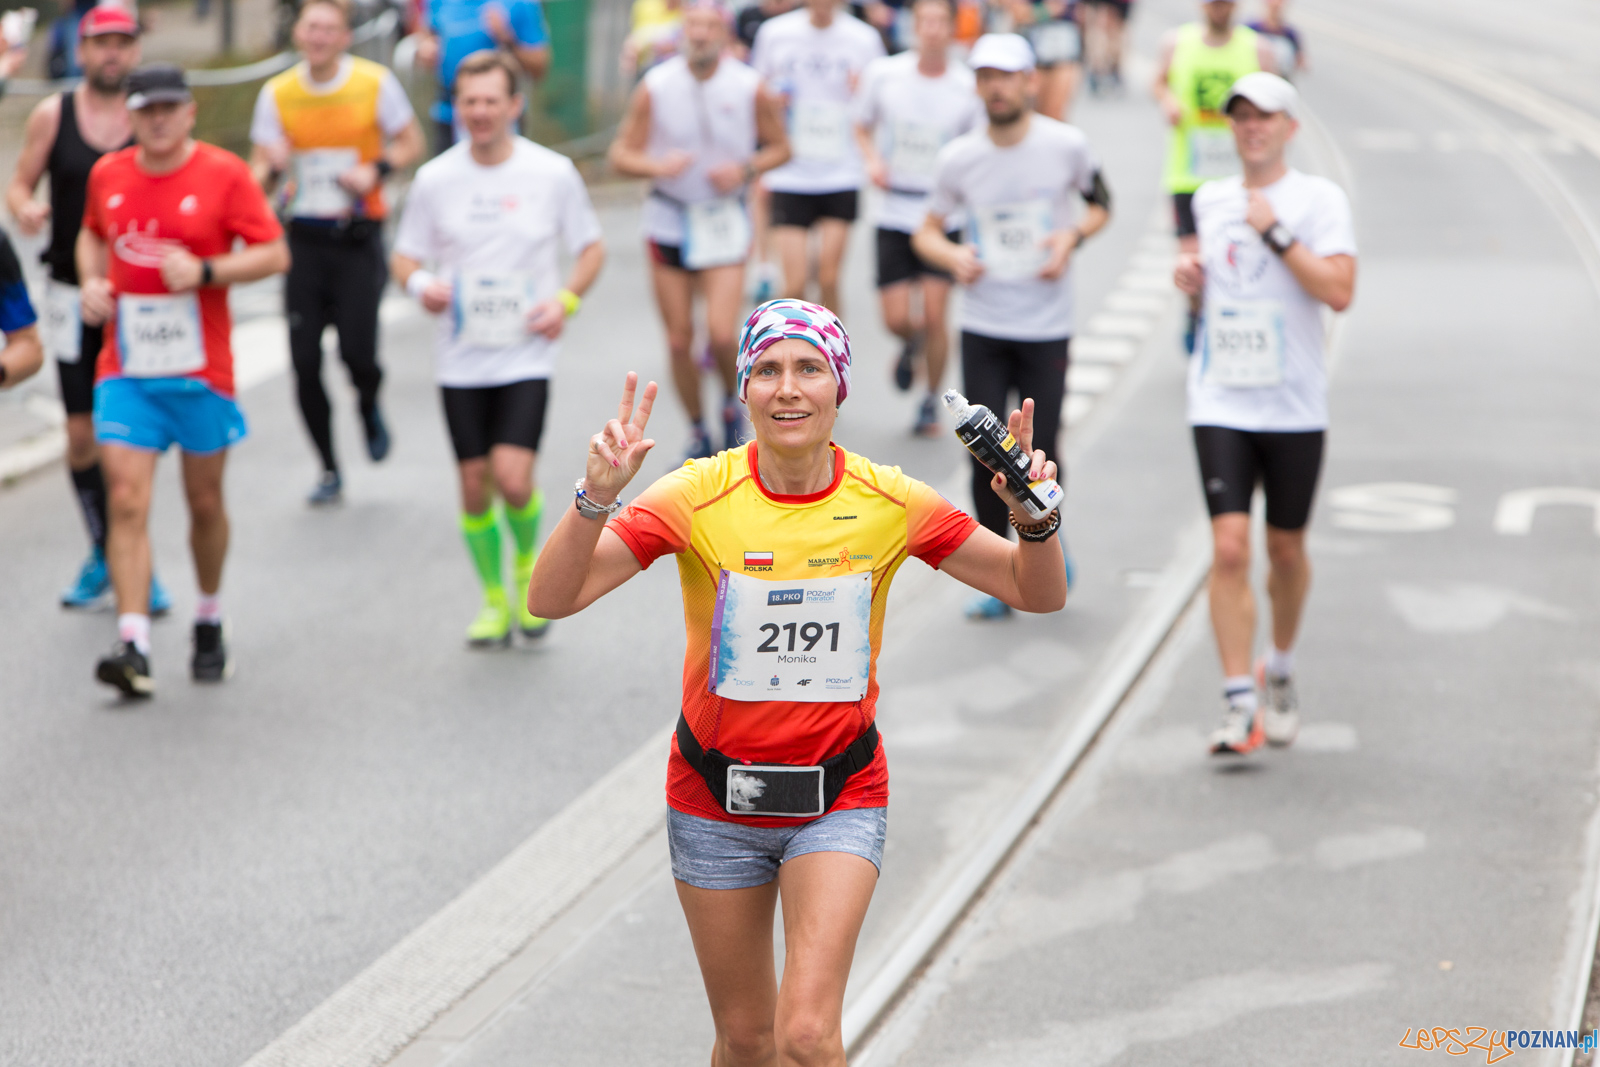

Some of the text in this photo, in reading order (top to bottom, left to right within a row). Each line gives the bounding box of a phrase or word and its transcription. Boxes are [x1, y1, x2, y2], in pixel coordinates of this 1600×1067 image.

[772, 593, 801, 602] 18. PKO
[757, 621, 840, 652] 2191
[777, 655, 817, 664] Monika
